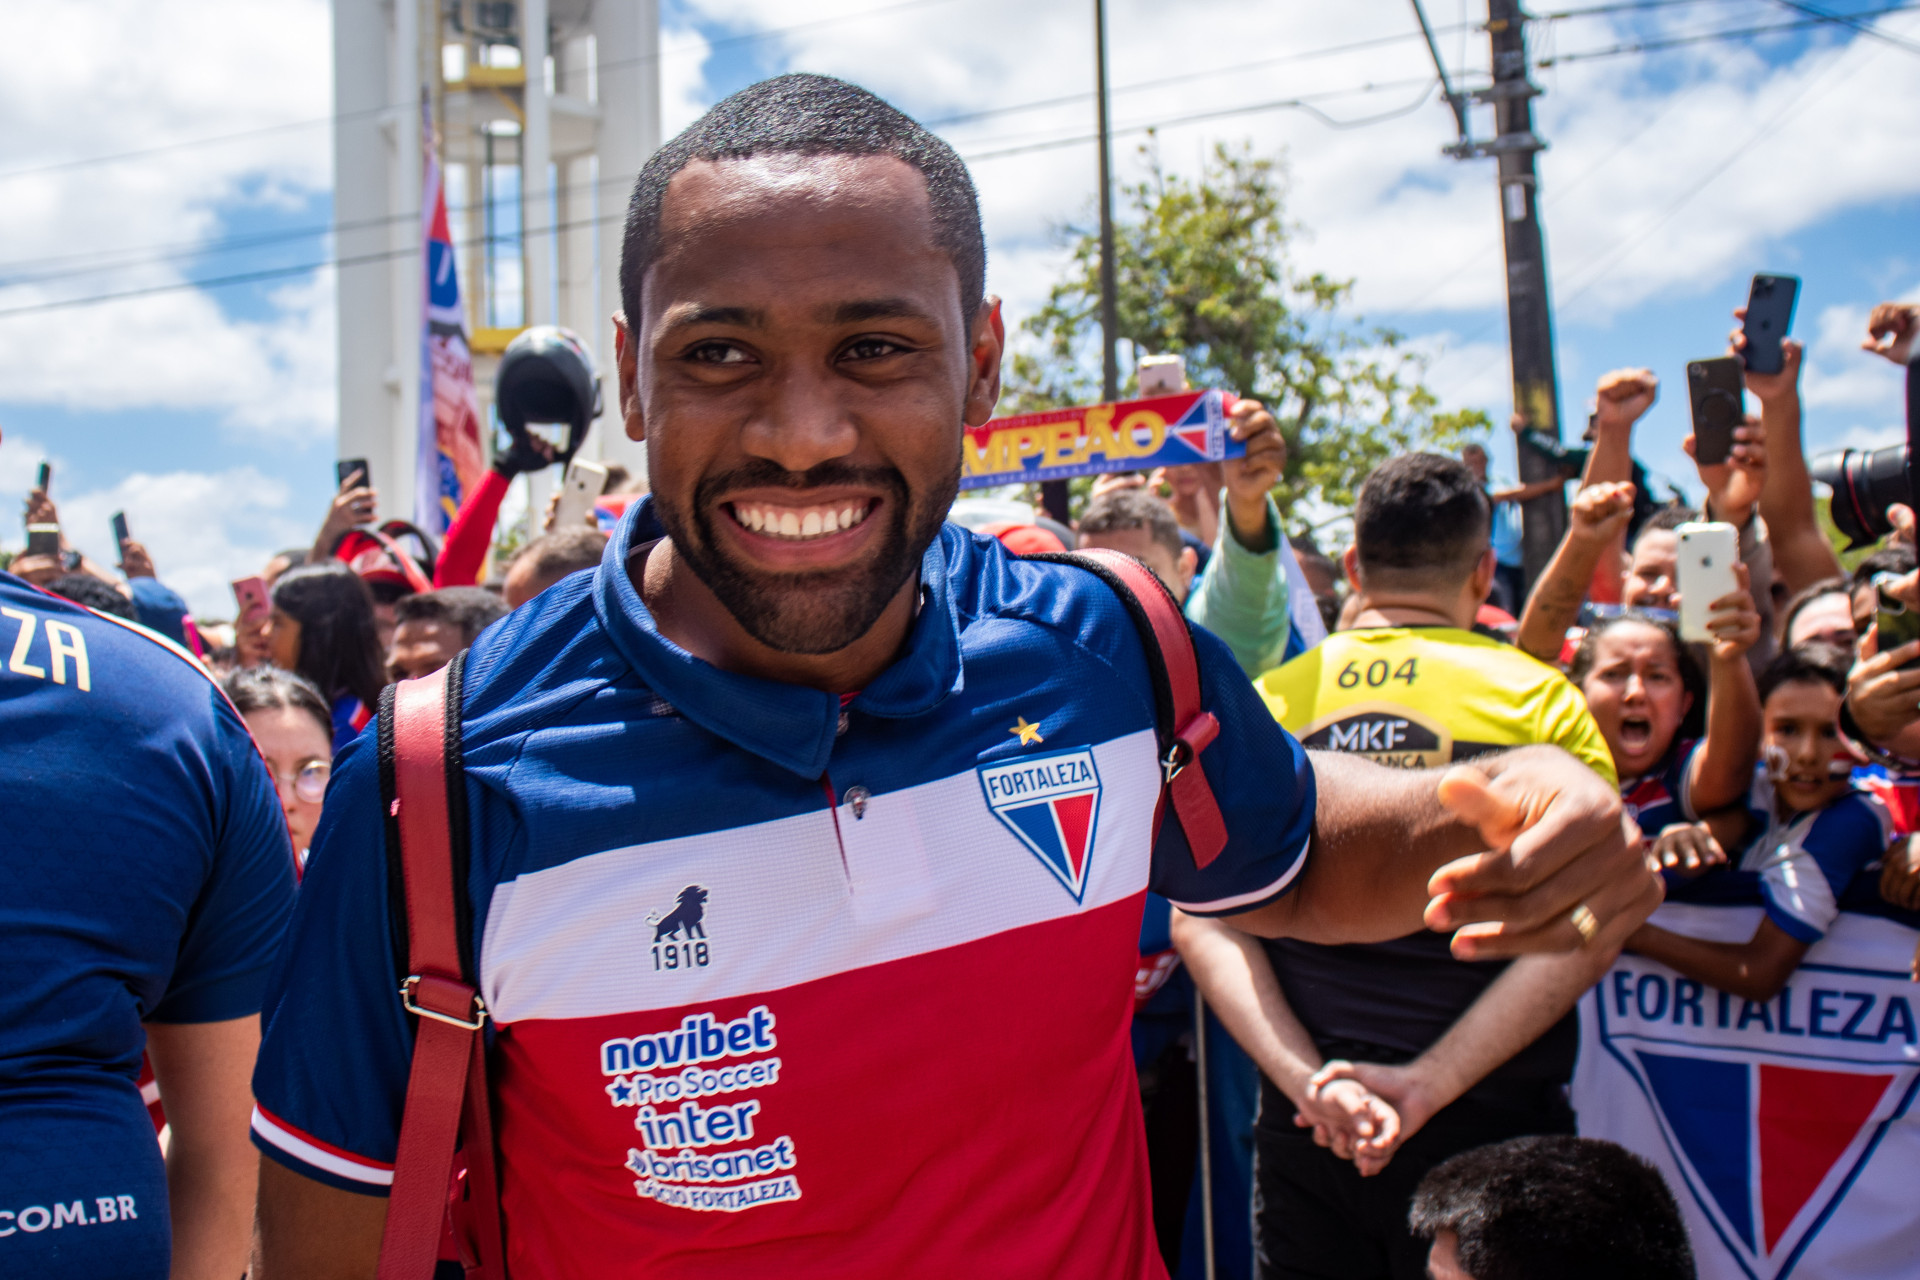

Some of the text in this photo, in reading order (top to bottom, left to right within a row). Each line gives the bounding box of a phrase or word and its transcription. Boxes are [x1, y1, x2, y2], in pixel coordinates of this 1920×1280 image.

[0, 606, 91, 692] ZA
[1338, 657, 1418, 688] 604
[1328, 719, 1409, 750] MKF
[987, 760, 1093, 799] FORTALEZA
[651, 941, 710, 971] 1918
[604, 1008, 774, 1073] novibet
[639, 1103, 757, 1147] inter
[647, 1141, 791, 1179] brisanet
[639, 1179, 797, 1209] ÓCIO FORTALEZA
